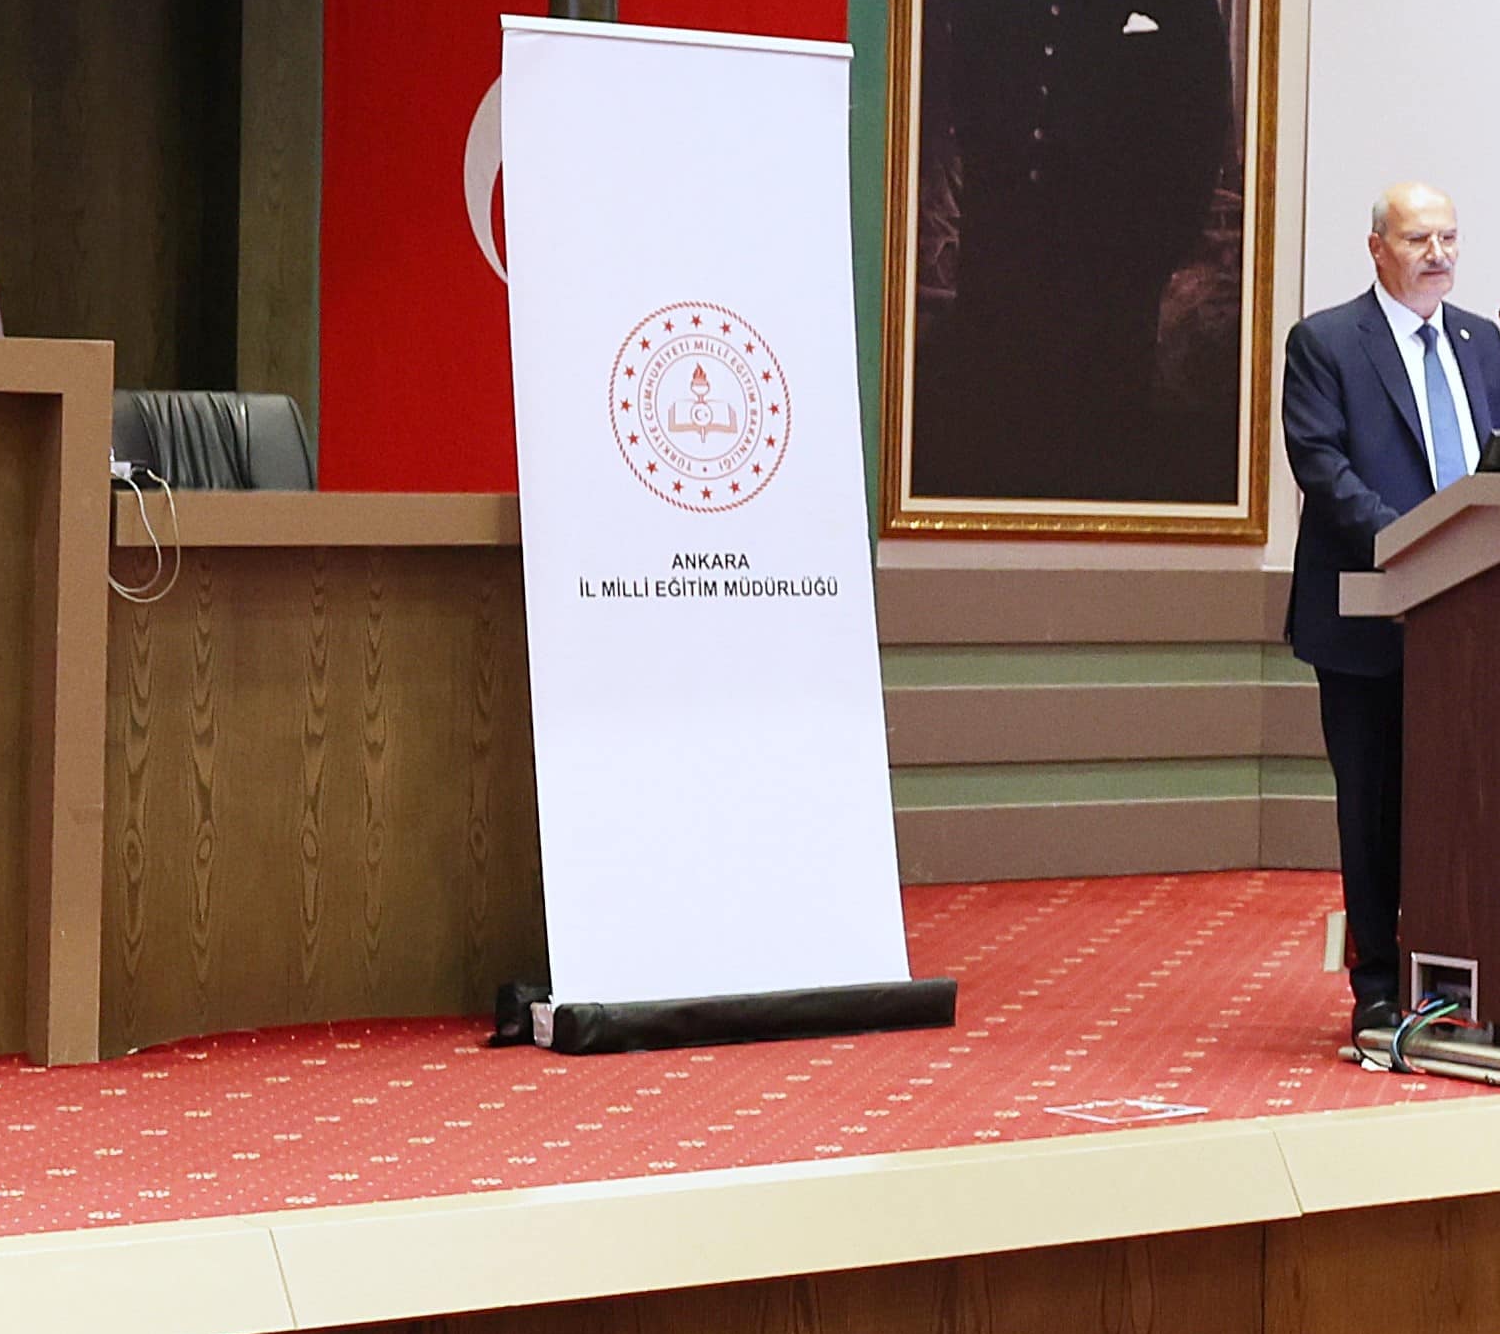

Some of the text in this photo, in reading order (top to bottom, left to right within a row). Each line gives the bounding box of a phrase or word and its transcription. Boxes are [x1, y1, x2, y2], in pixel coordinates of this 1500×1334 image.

[671, 552, 750, 570] ANKARA
[579, 576, 838, 598] İL MİLLİ EĞİTİM MÜDÜRLÜĞÜ
